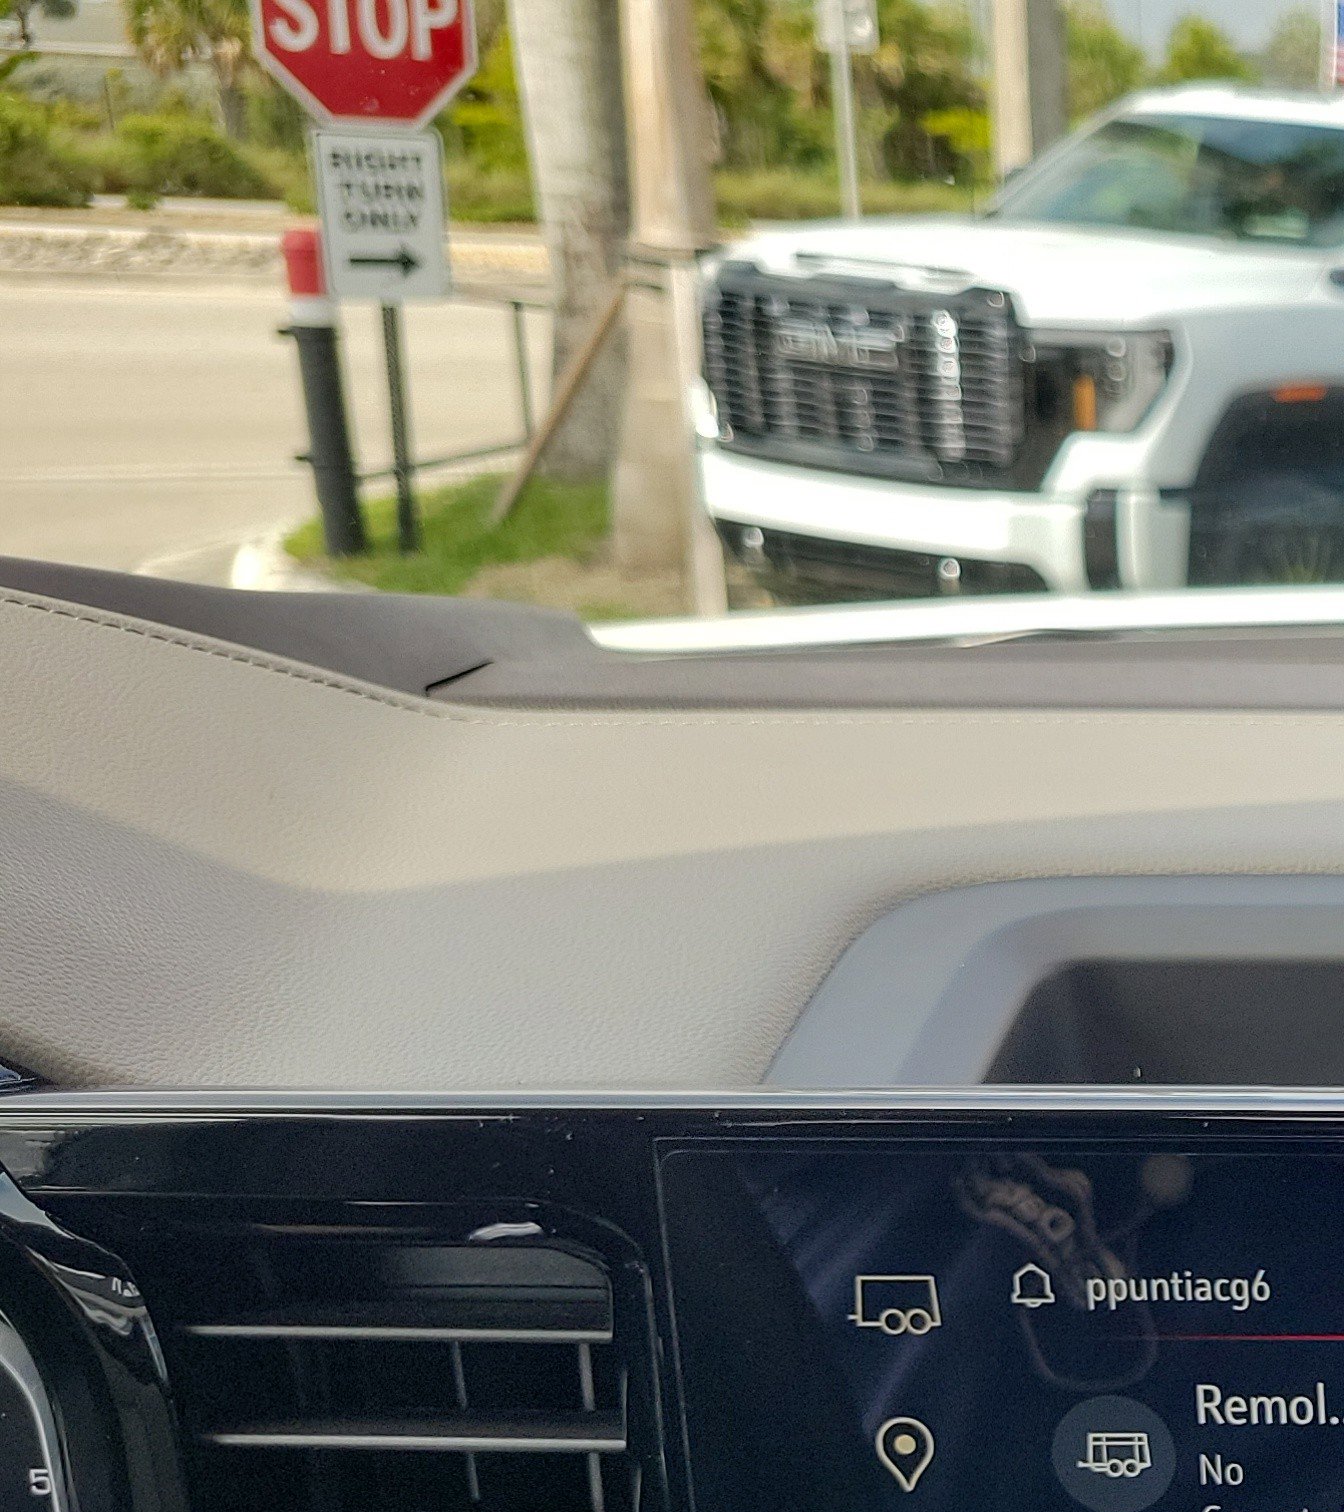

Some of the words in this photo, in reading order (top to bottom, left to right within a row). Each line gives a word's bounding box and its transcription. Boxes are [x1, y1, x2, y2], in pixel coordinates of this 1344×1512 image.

[268, 0, 457, 60] STOP
[1086, 1269, 1271, 1311] ppuntiacg6
[28, 1467, 52, 1496] 5
[1199, 1453, 1244, 1486] No
